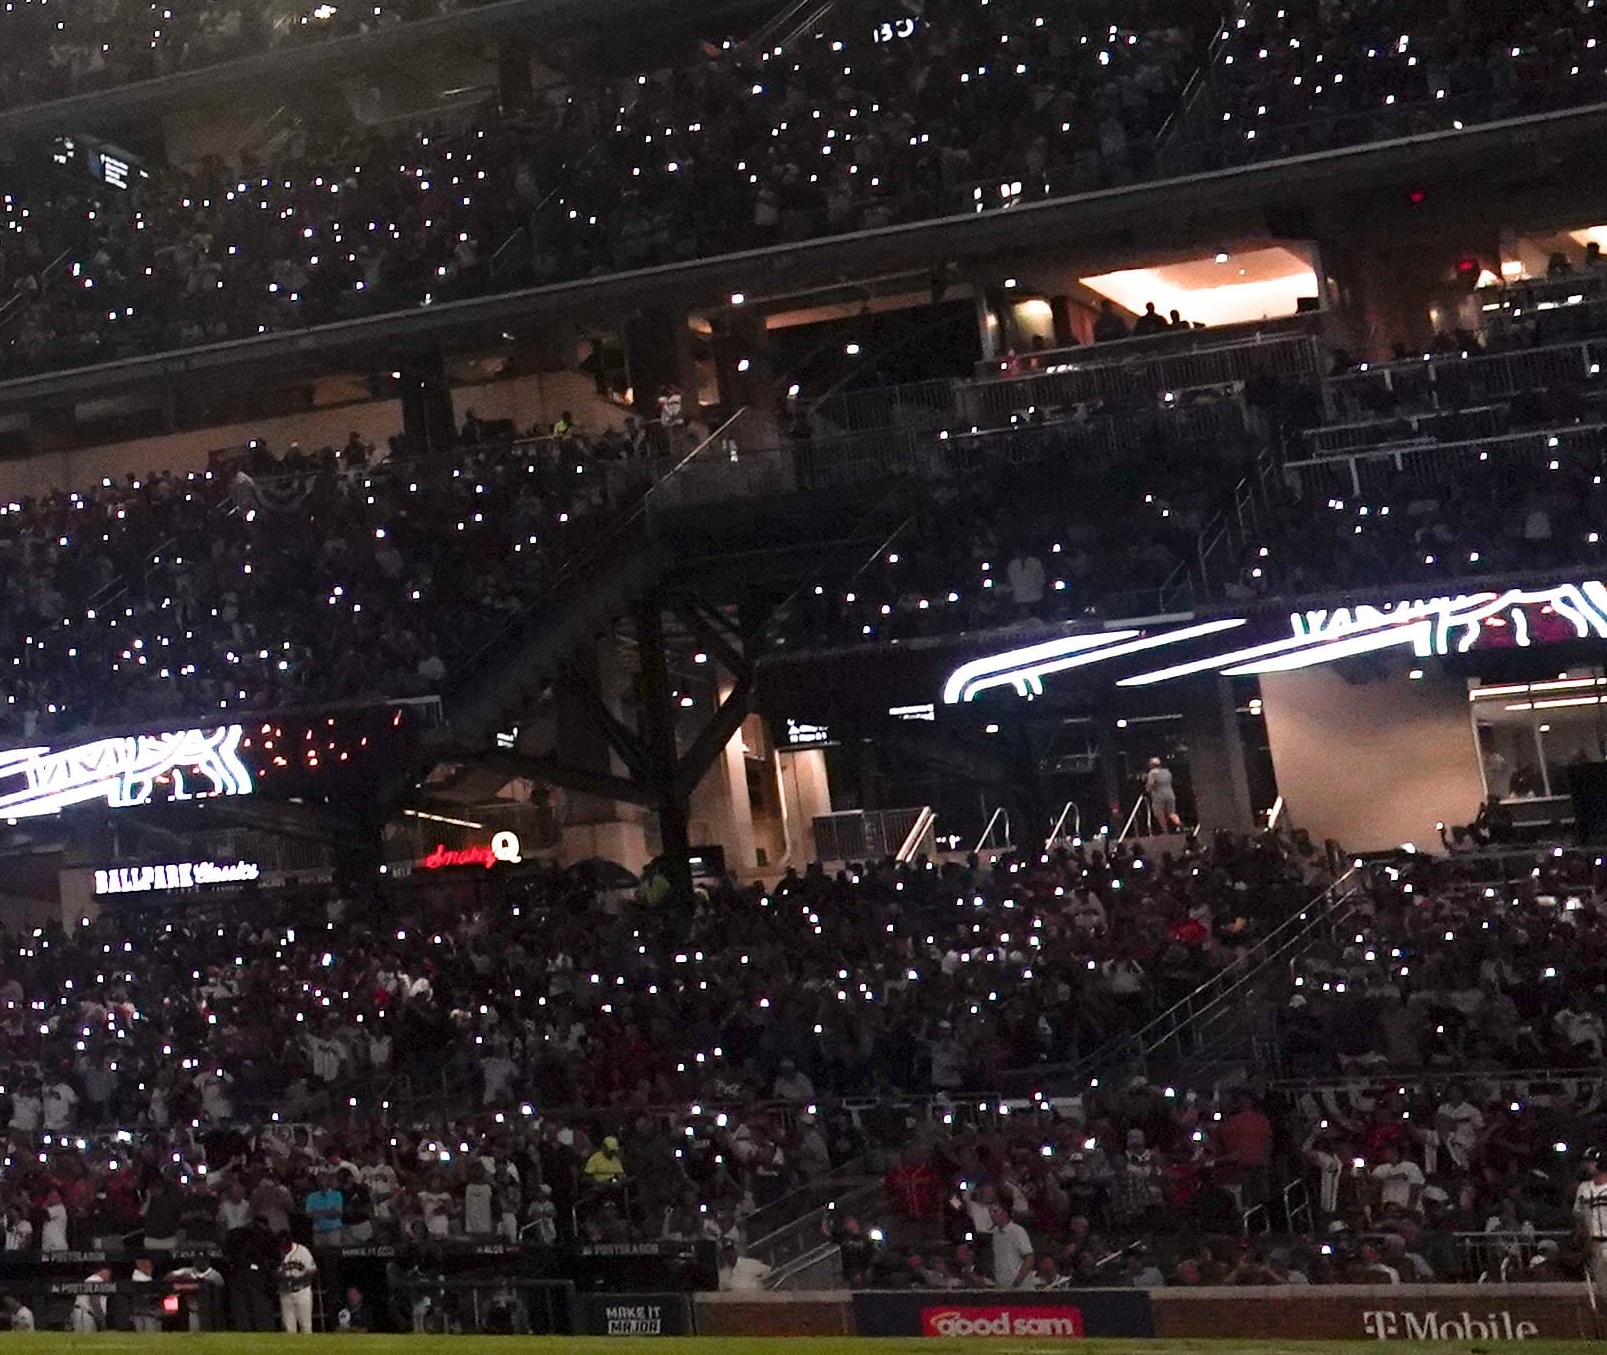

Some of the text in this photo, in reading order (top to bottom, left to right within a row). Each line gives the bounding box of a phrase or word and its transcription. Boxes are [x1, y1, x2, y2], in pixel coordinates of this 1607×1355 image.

[491, 830, 522, 863] Q
[94, 863, 194, 894] BALLPARK
[606, 1306, 645, 1319] MAKE
[935, 1311, 1074, 1337] good sam
